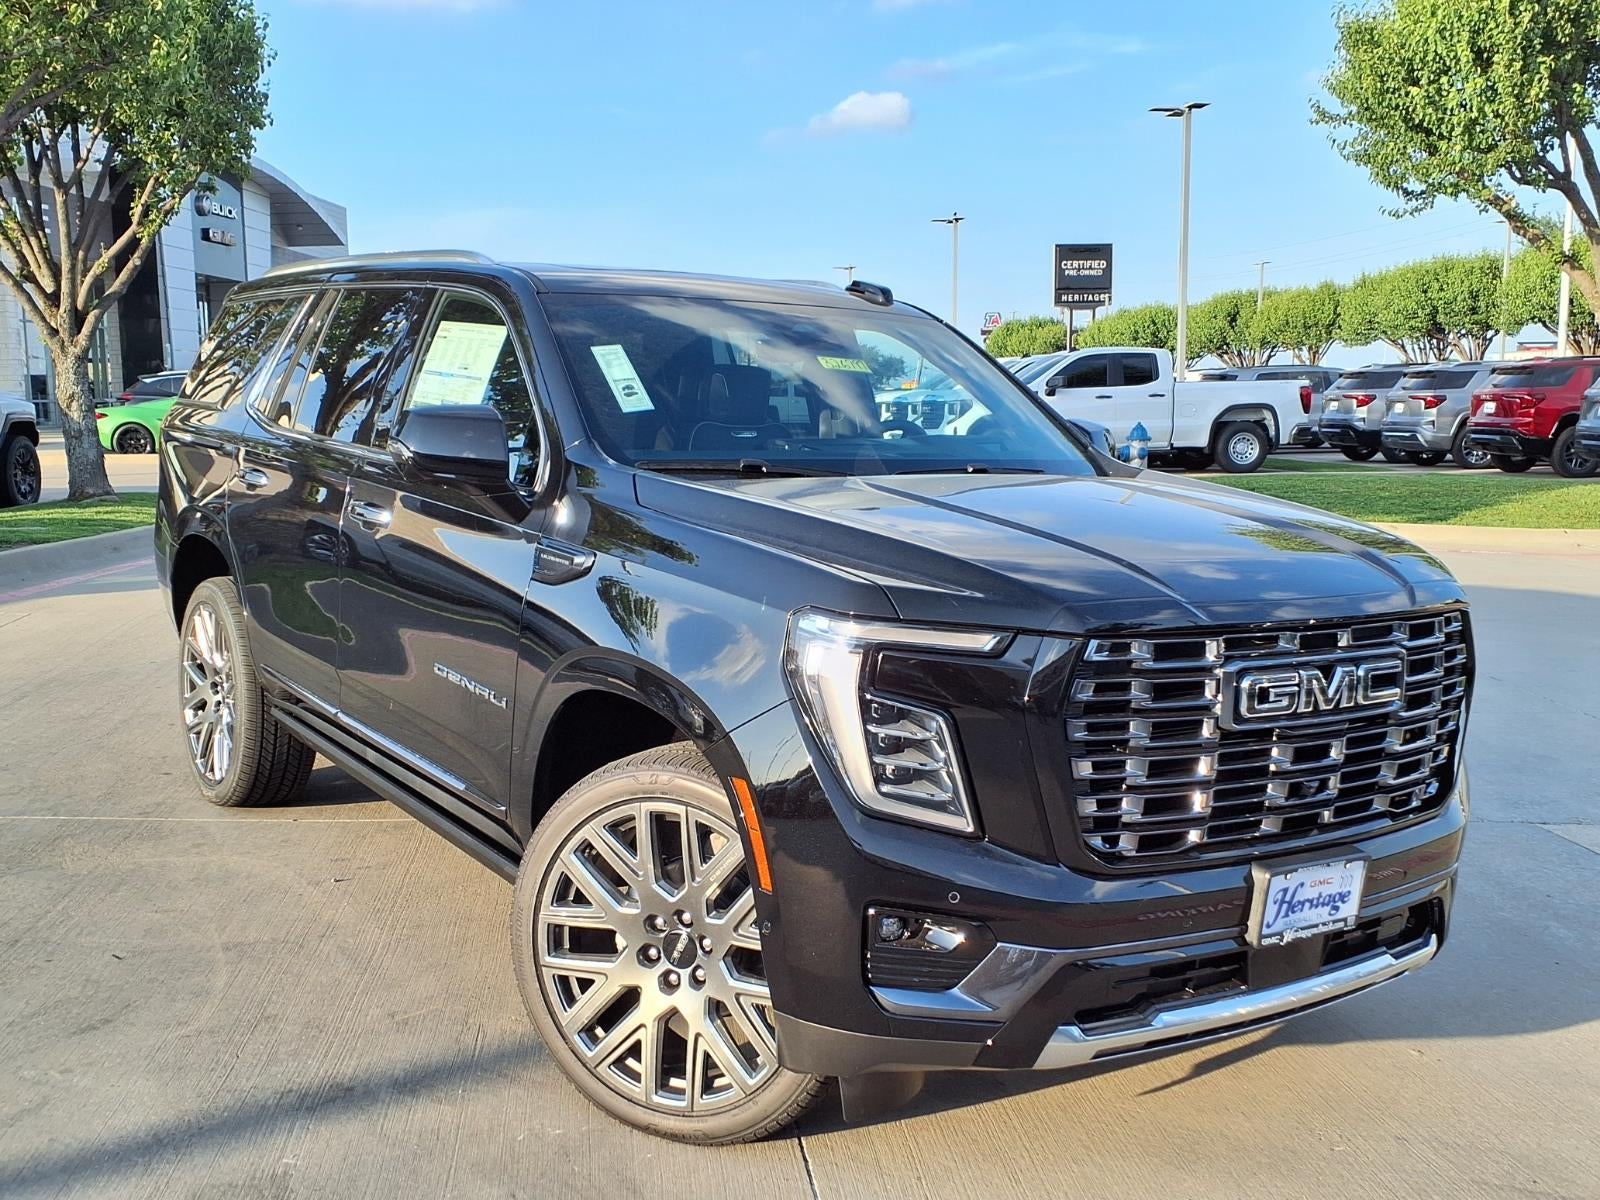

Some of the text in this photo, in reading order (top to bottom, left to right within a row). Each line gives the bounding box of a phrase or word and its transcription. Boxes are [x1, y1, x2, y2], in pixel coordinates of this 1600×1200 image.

[211, 202, 238, 219] BUICK
[1061, 260, 1107, 269] CERTIFIED
[1061, 293, 1106, 302] HERITAGE
[1240, 659, 1402, 718] GMC
[1309, 877, 1335, 888] GMC
[1264, 881, 1352, 930] Heritage
